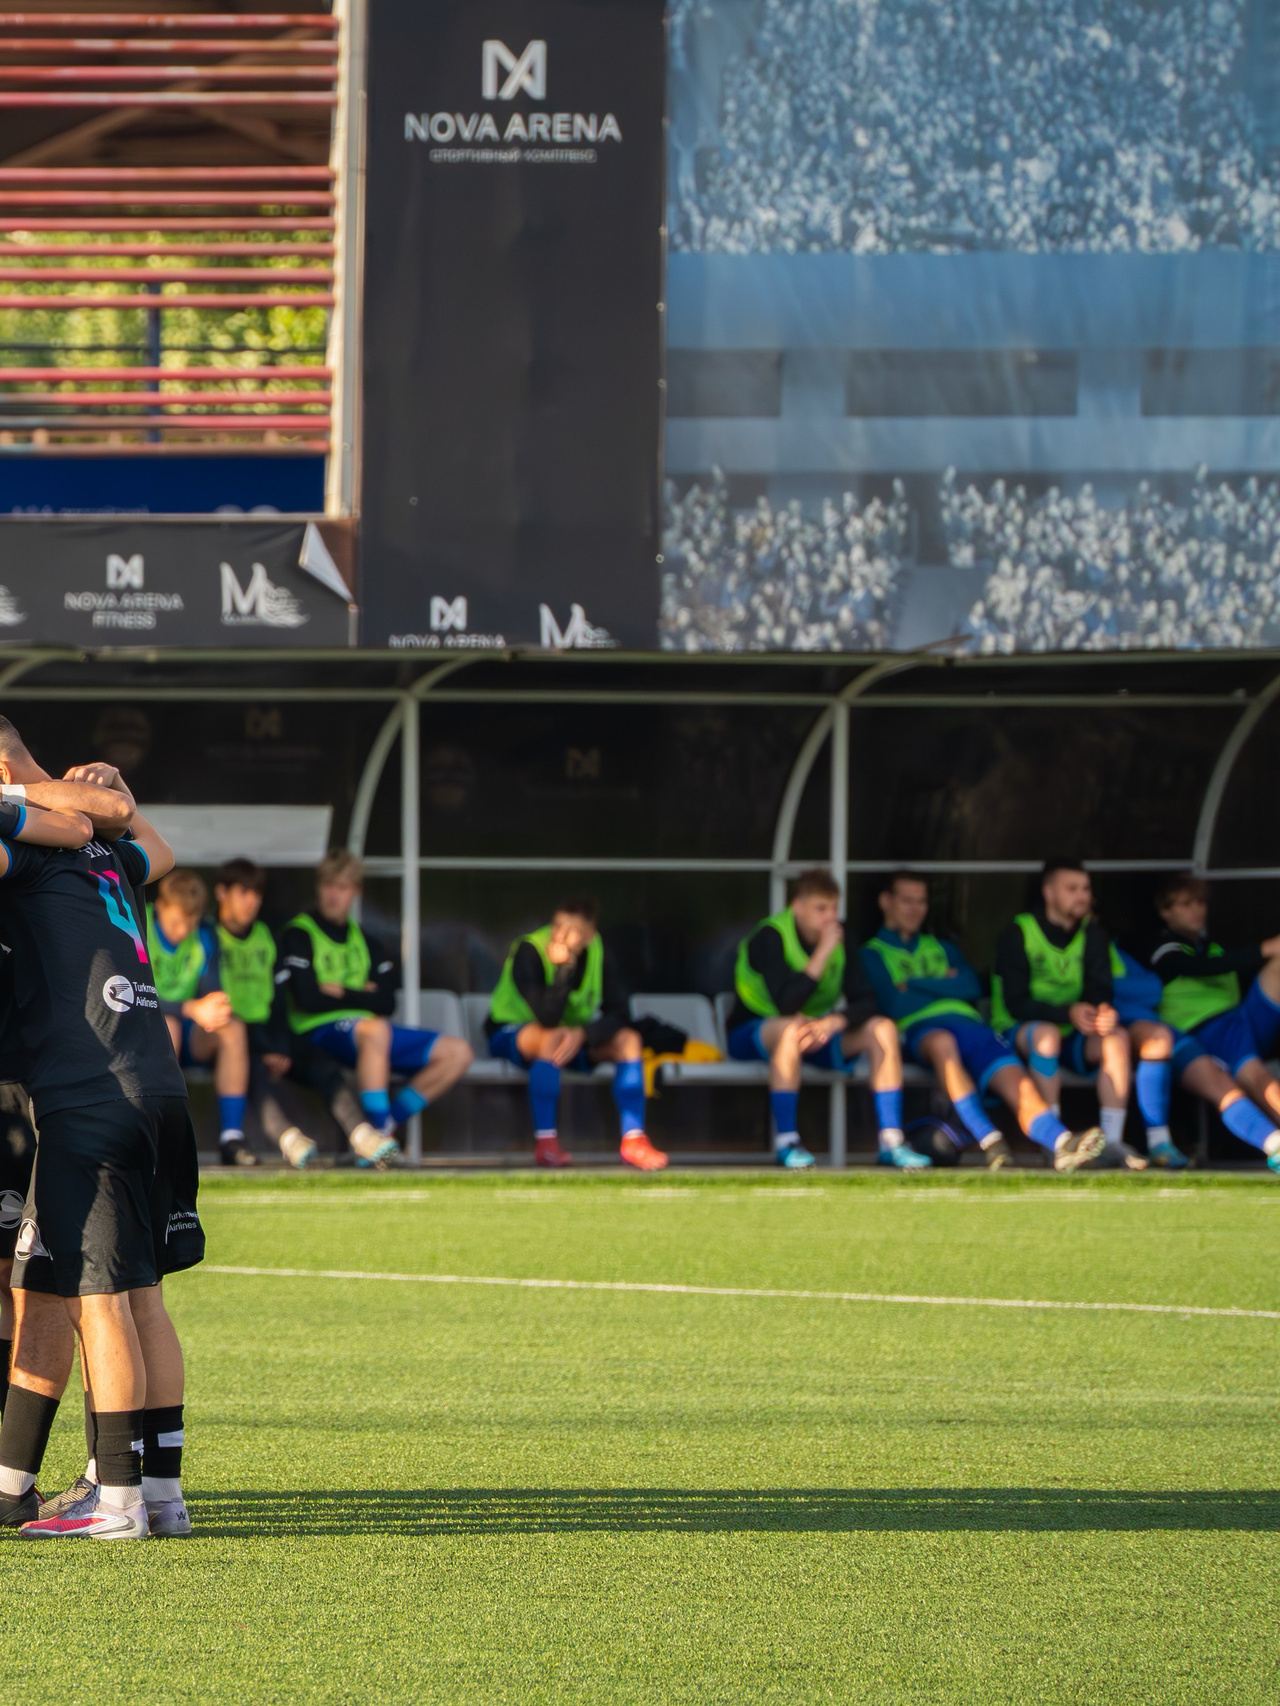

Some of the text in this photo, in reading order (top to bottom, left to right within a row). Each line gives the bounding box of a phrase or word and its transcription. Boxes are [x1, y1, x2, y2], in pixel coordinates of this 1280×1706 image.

[404, 112, 623, 142] NOVA ARENA
[64, 592, 184, 611] NOVA ARENA
[91, 611, 157, 629] FITNESS
